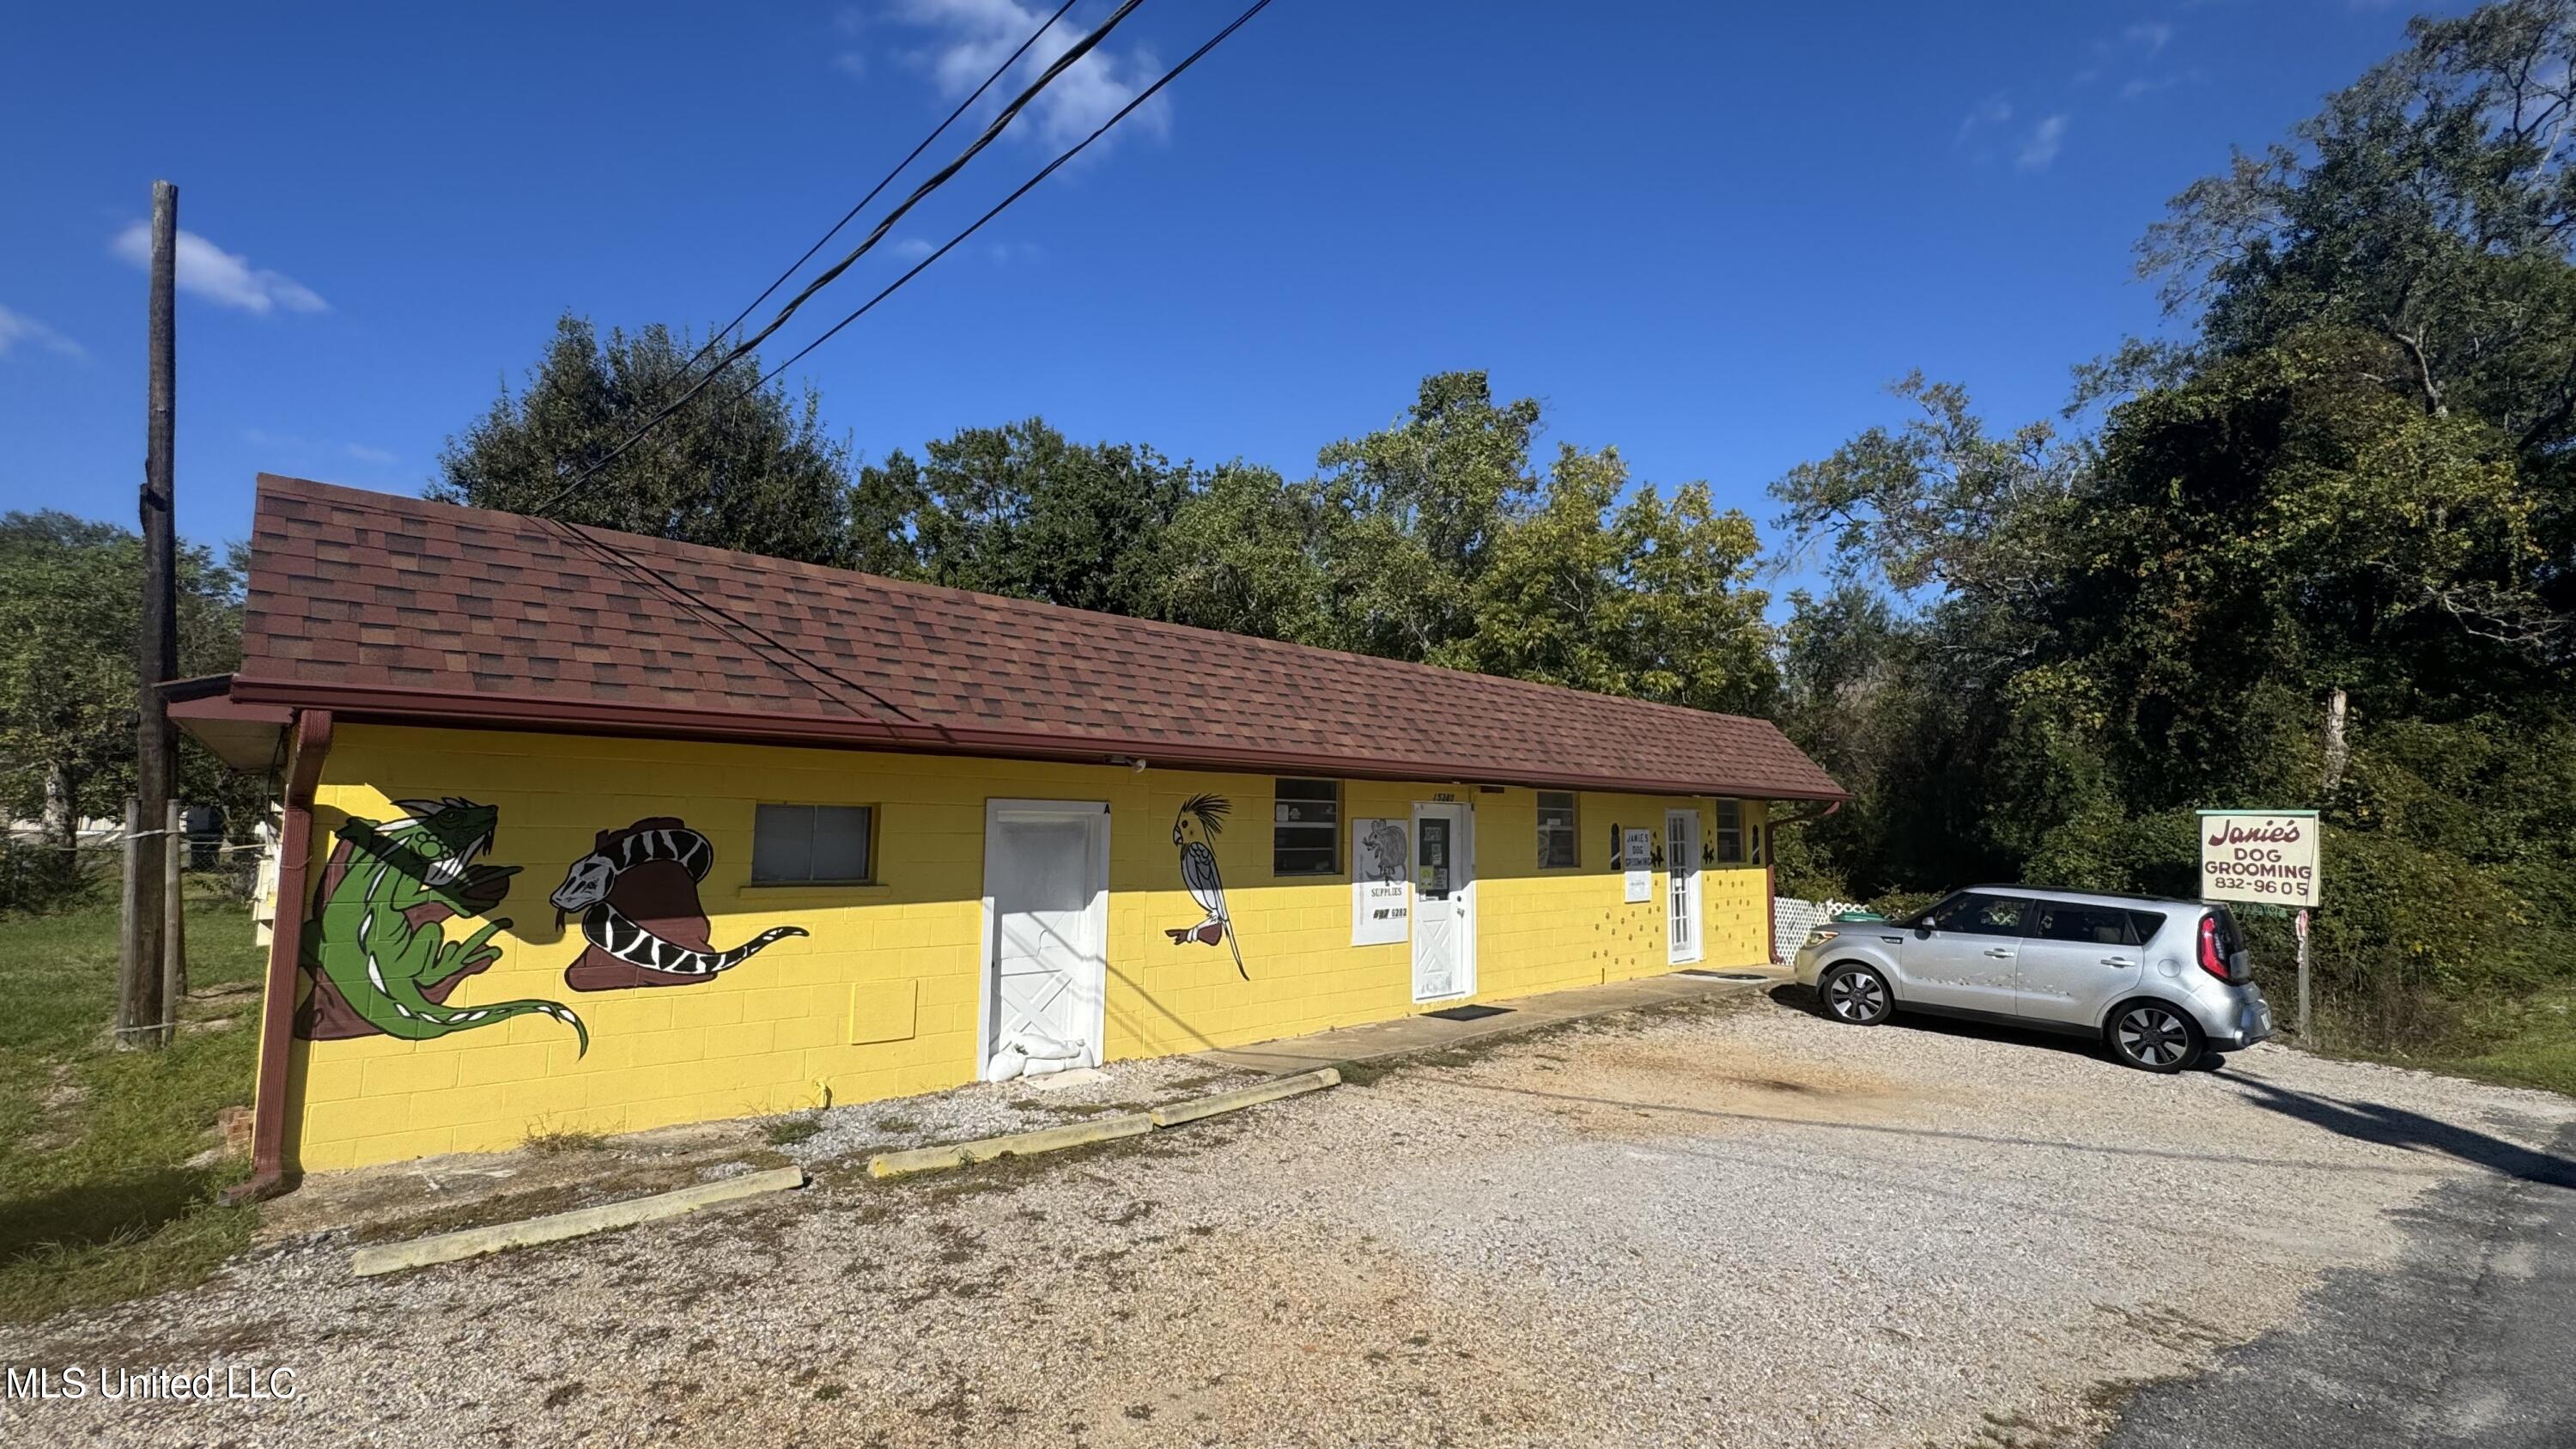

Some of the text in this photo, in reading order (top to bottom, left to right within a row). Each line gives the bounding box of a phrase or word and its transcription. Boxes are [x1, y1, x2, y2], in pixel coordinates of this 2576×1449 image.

[2208, 819, 2300, 846] Janie's
[1632, 845, 1643, 855] DOG
[2234, 848, 2282, 862] DOG
[1378, 865, 1395, 877] PETS
[2205, 861, 2312, 880] GROOMING
[1371, 887, 1402, 897] SUPPLIES
